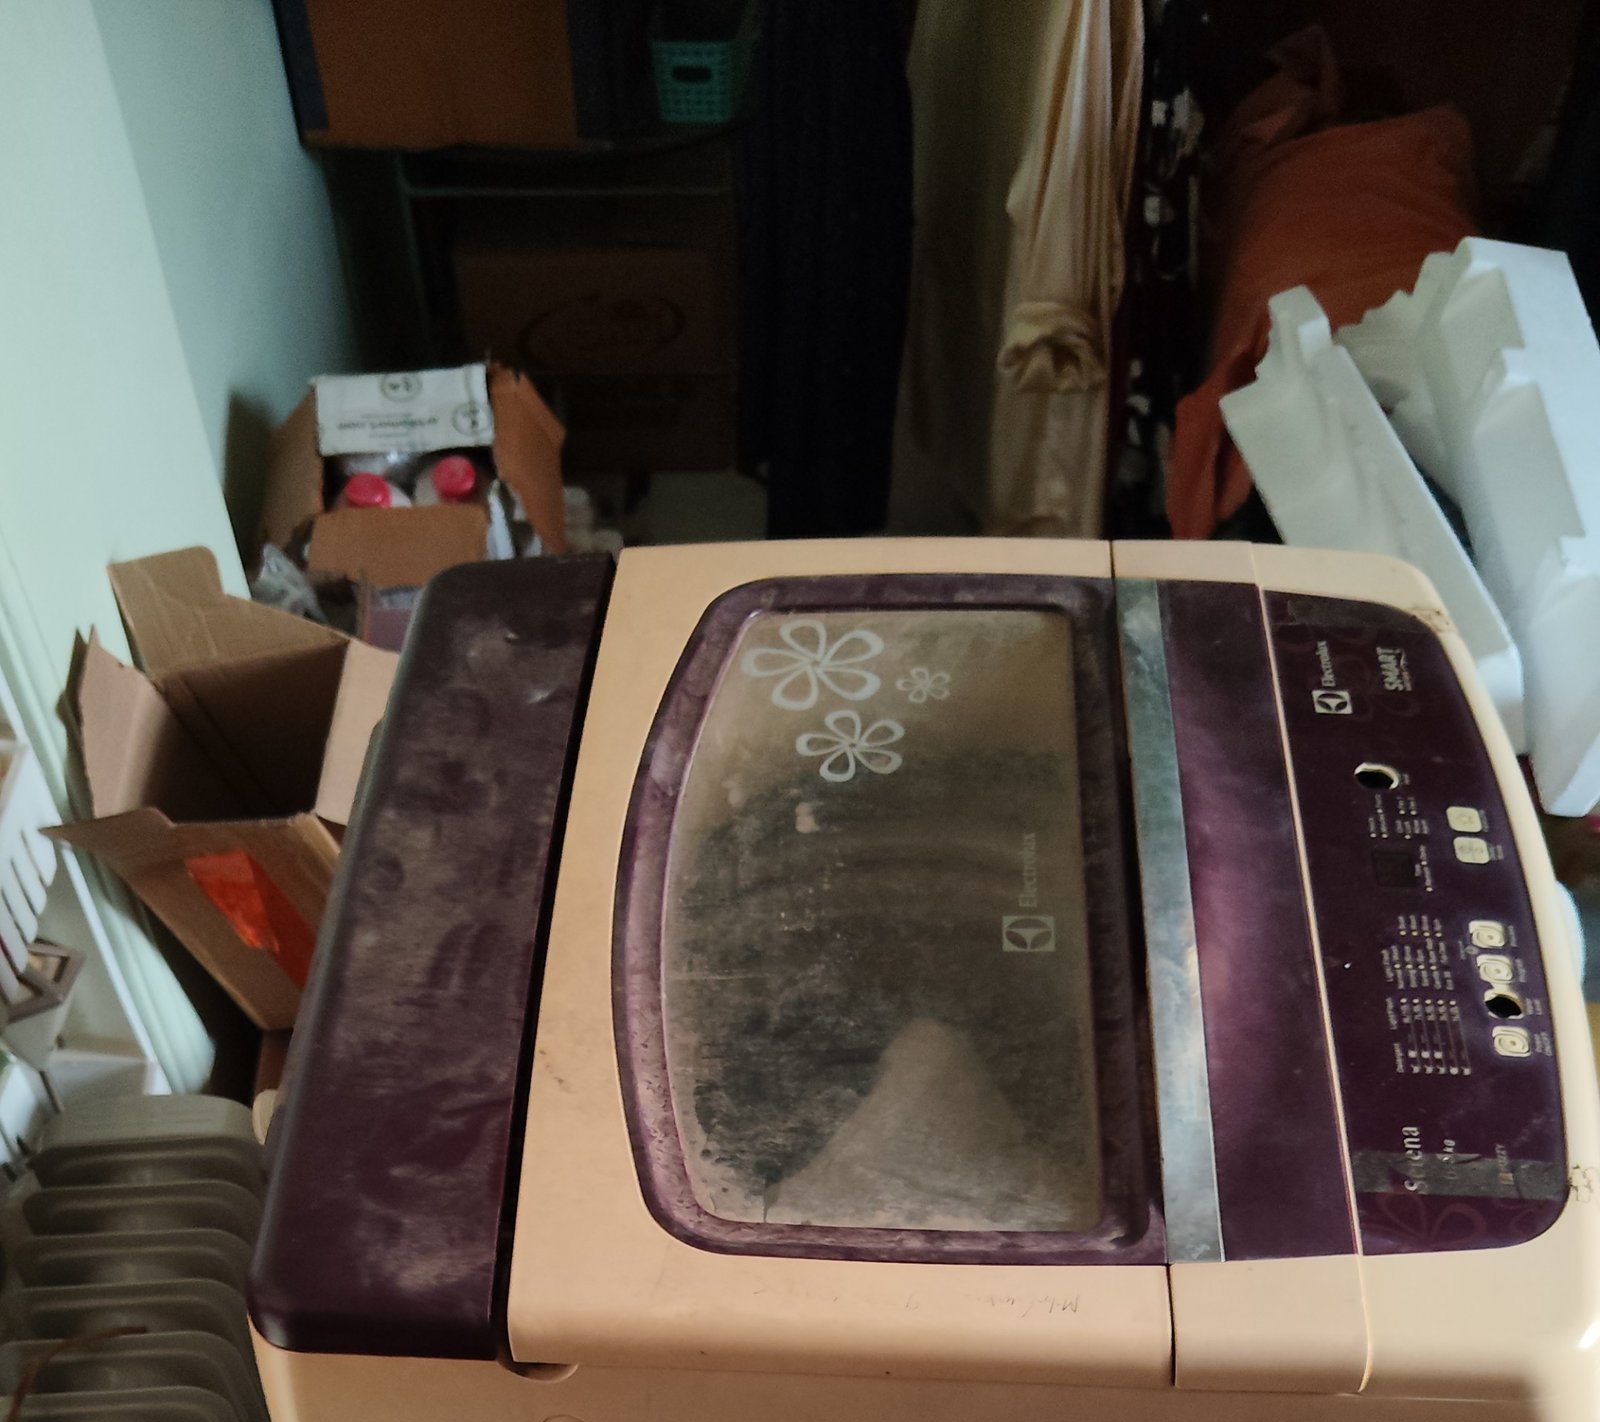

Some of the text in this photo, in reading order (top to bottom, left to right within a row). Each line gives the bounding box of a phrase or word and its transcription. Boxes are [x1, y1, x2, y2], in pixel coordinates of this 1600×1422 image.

[1316, 641, 1336, 687] Electrolux
[1376, 646, 1404, 691] SMART
[1019, 832, 1038, 908] Electrolux
